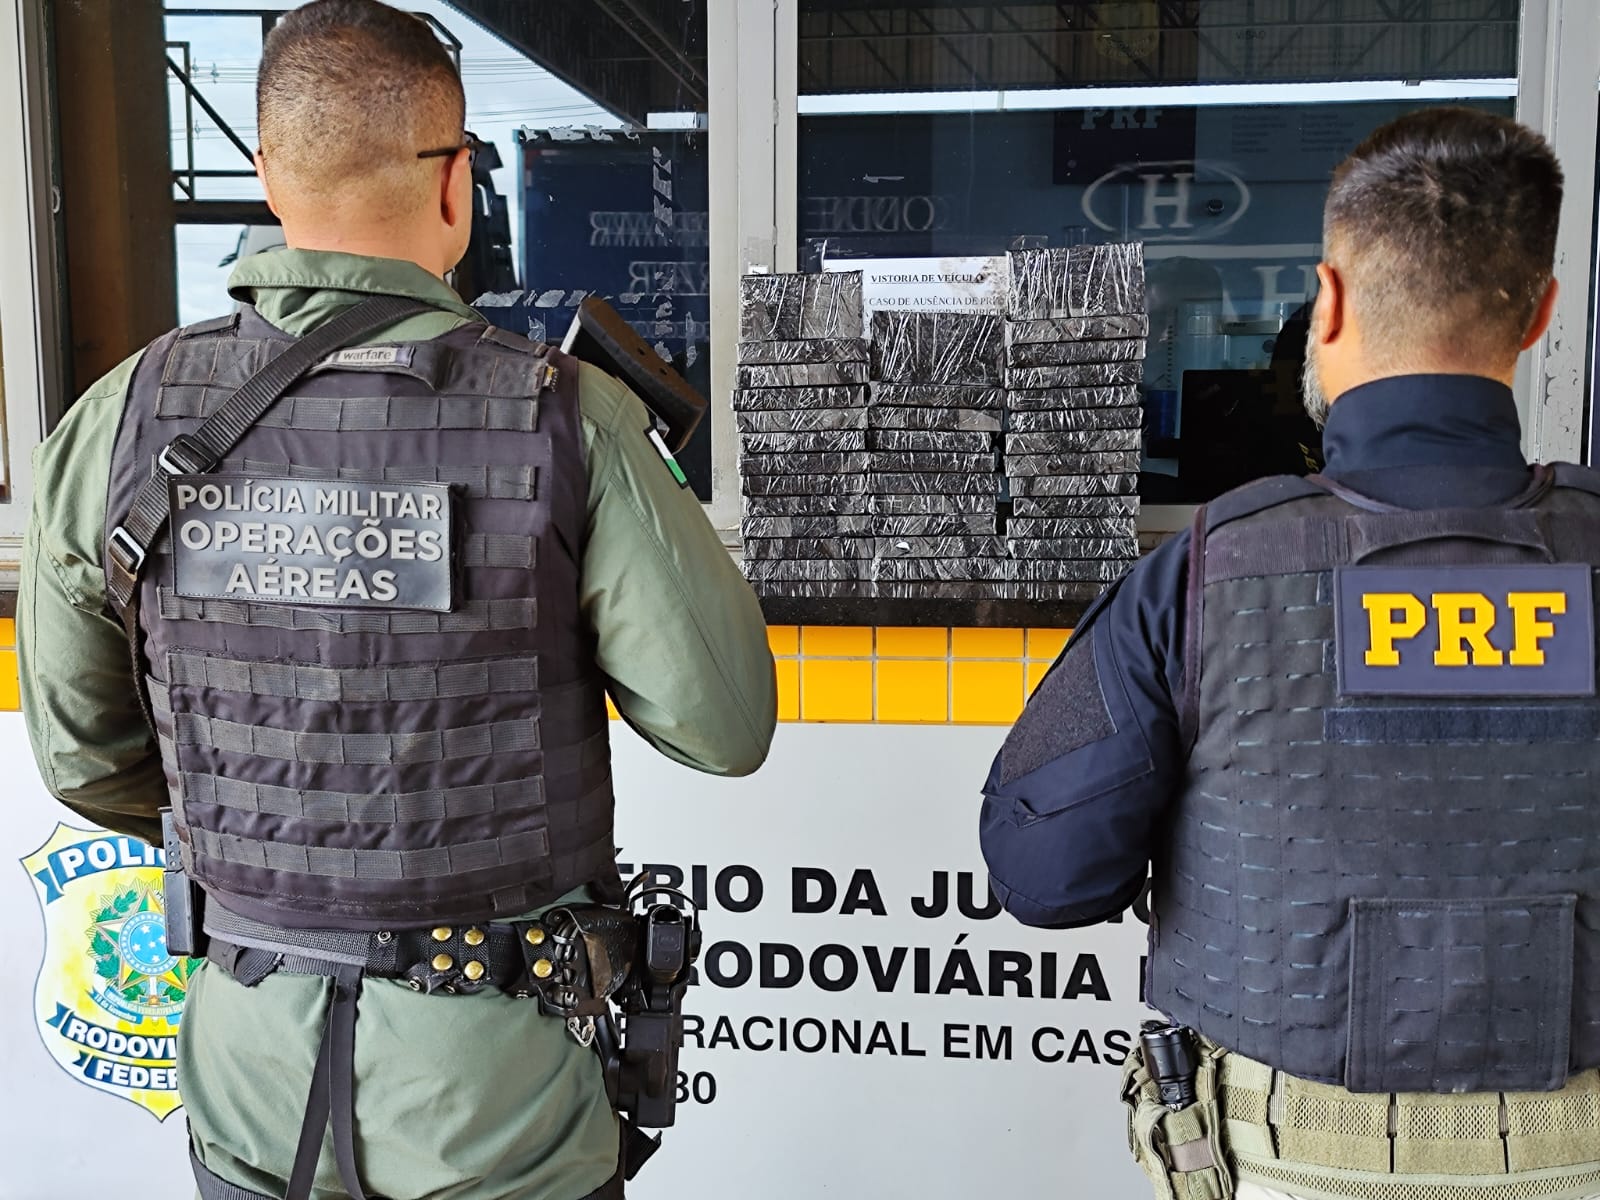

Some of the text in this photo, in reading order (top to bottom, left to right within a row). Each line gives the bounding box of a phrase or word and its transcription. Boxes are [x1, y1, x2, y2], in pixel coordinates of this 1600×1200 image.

[871, 274, 919, 283] VISTORIA
[921, 274, 935, 283] DE
[869, 297, 896, 306] CASO
[898, 297, 911, 306] DE
[914, 295, 962, 306] AUSÊNCIA
[964, 296, 978, 306] DE
[343, 349, 392, 360] warfare
[176, 479, 441, 519] POLÍCIA MILITAR
[180, 518, 443, 563] OPERAÇÕES
[225, 557, 398, 601] AÉREAS
[1362, 592, 1567, 666] PRF
[792, 867, 888, 916] DA
[911, 870, 1002, 920] JU
[66, 1017, 177, 1059] RODOVI
[677, 1014, 1132, 1066] RACIONAL EM CAS
